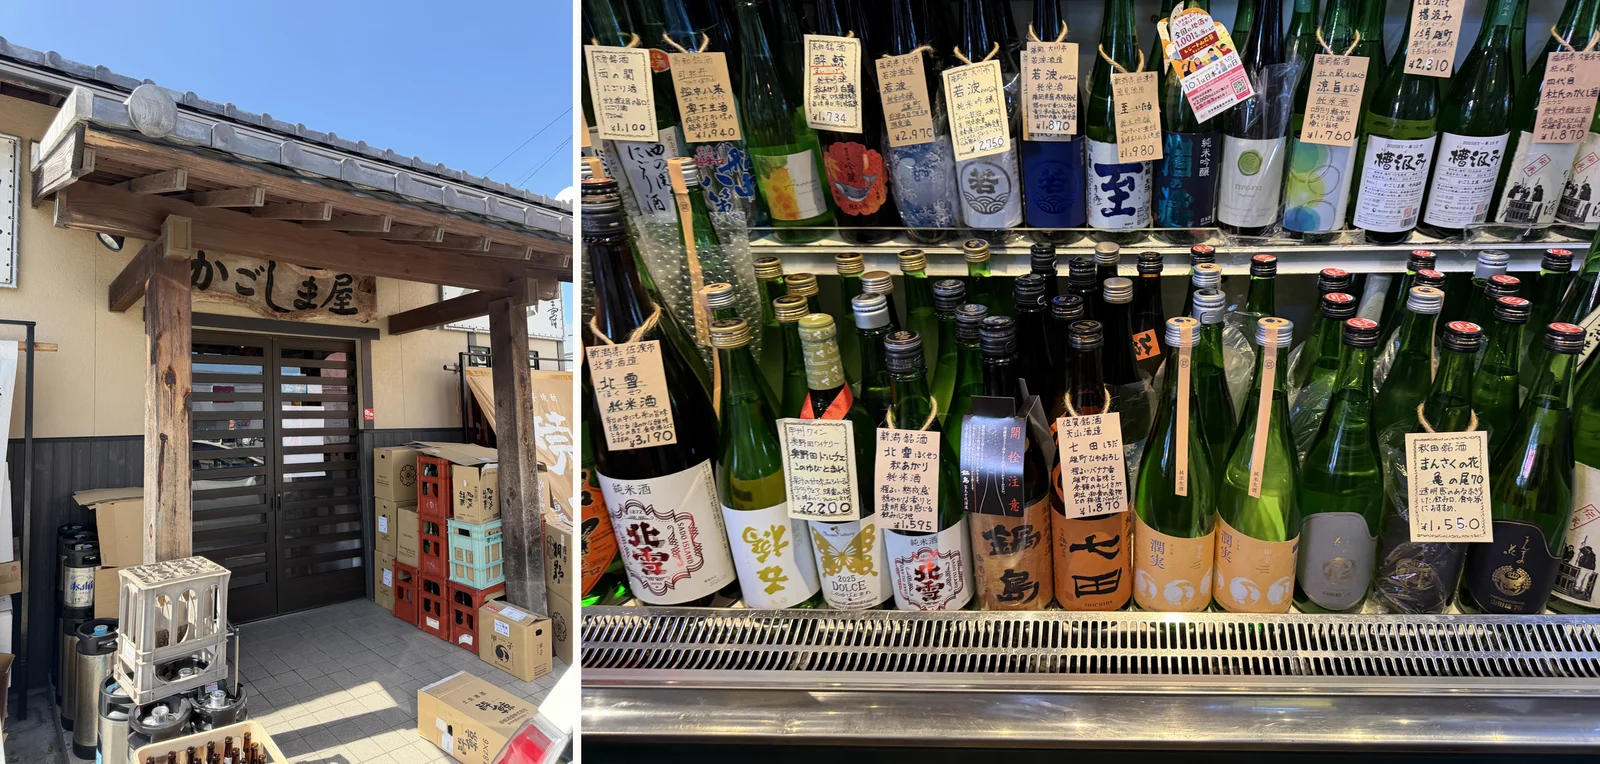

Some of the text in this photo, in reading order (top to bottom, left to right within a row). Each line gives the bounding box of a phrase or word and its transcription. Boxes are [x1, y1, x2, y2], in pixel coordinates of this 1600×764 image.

[813, 54, 847, 67] 酔鯨
[1317, 56, 1350, 66] 福岡銘酒
[1408, 57, 1449, 72] ¥2,310
[1032, 68, 1058, 80] 若波
[884, 80, 906, 92] 若波
[953, 80, 981, 98] 若波
[1037, 83, 1063, 91] 純米酒
[1120, 102, 1129, 114] 至
[1316, 96, 1350, 107] 純米酒
[812, 112, 847, 122] ¥1,734
[1036, 120, 1071, 131] ¥1,870
[695, 128, 735, 140] ¥1,940
[895, 128, 933, 141] ¥2,970
[1307, 130, 1352, 141] ¥1,760
[1119, 144, 1155, 158] ¥1,980
[1199, 137, 1212, 177] 純米吟醸
[1374, 151, 1427, 171] 槽汲み
[1448, 148, 1501, 168] 槽汲み
[1094, 163, 1144, 218] 至
[190, 249, 358, 315] かごしま屋
[599, 372, 639, 390] 北雪
[608, 394, 657, 413] 純米酒
[1061, 416, 1102, 428] 佐賀銘酒
[789, 426, 805, 436] 甲州
[1066, 427, 1103, 438] 天山酒造
[629, 430, 673, 447] ¥3,190
[790, 437, 840, 447] 奥野田ワイナリー
[880, 431, 928, 445] 新潟銘酒
[1069, 439, 1118, 452] 七田 しちだ
[1418, 442, 1467, 453] 秋田銘酒
[884, 446, 912, 459] 北雪
[890, 460, 929, 472] 秋あがり
[1007, 425, 1021, 513] 開栓注意
[1420, 456, 1480, 470] まんさくの花
[886, 472, 921, 483] 純米酒
[1432, 472, 1484, 486] 亀の尾70
[612, 483, 652, 495] 純米酒
[894, 520, 932, 530] ¥1,595
[677, 522, 694, 565] SADO ISLAND
[910, 536, 938, 546] 純米酒
[1220, 530, 1233, 563] 潤実
[626, 521, 670, 576] 北雪
[1150, 538, 1165, 570] 潤実
[982, 524, 1042, 605] 鍋島
[1069, 533, 1122, 598] 七田
[70, 580, 94, 591] Asahi
[832, 580, 867, 592] DOLCE
[914, 562, 945, 602] 北雪
